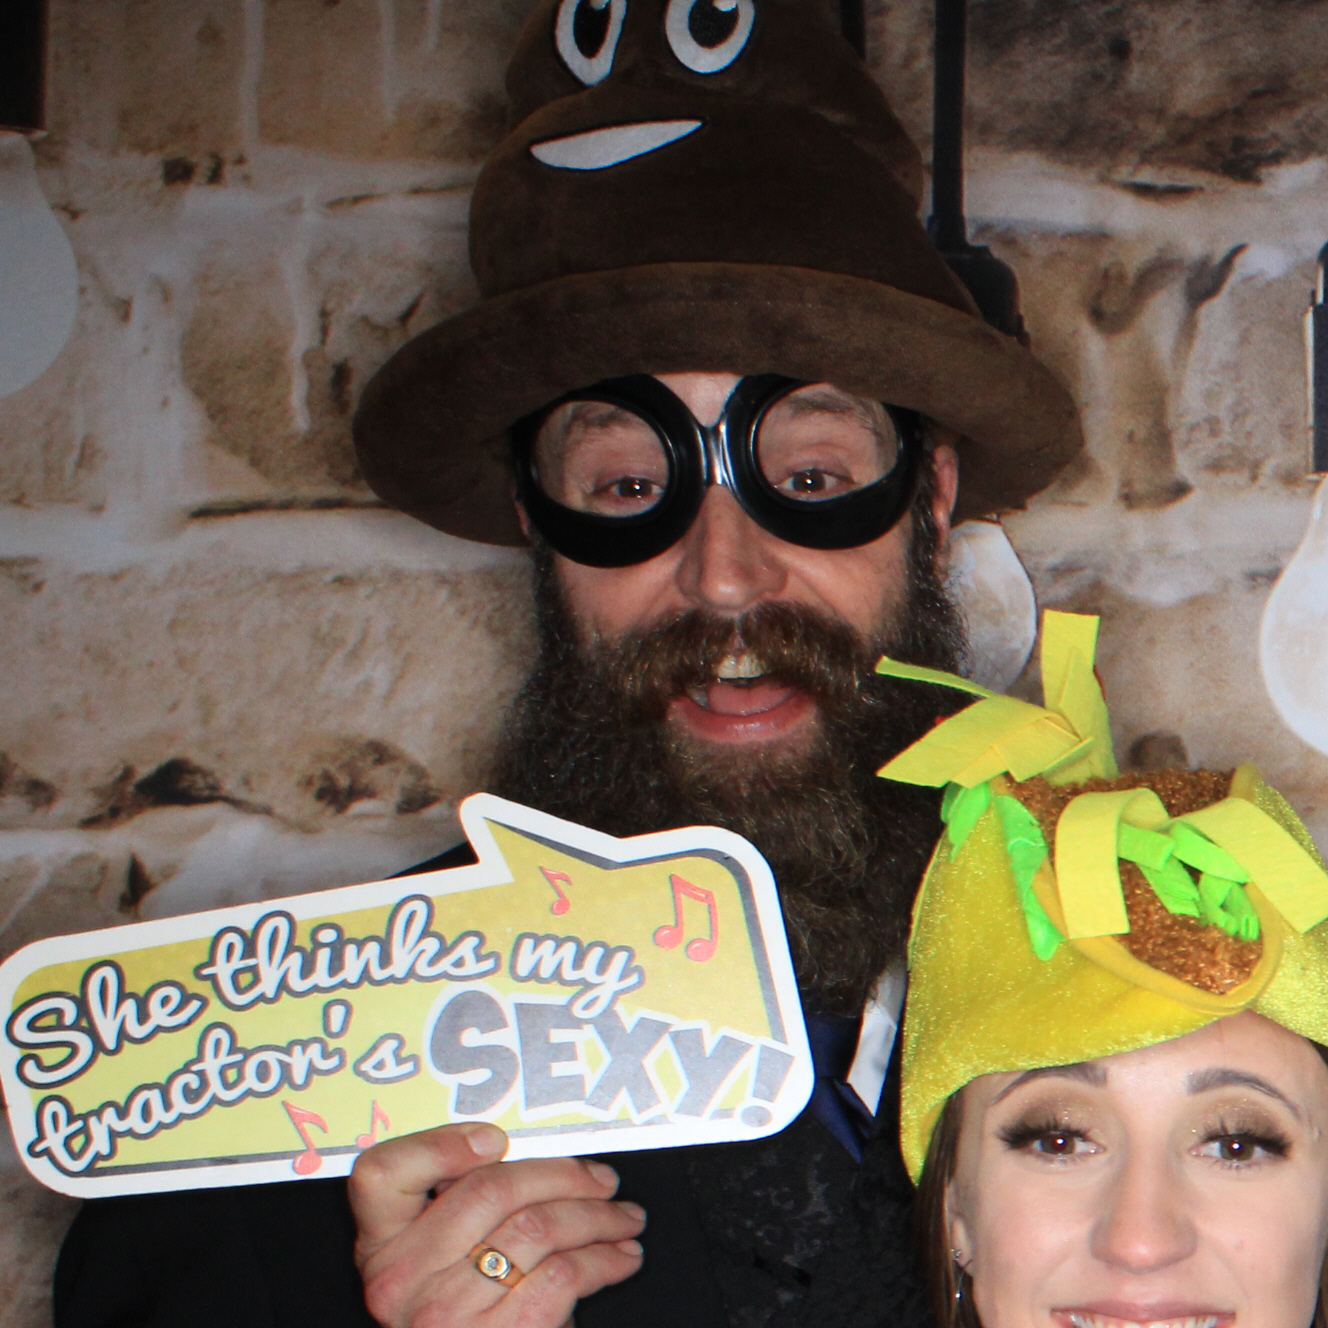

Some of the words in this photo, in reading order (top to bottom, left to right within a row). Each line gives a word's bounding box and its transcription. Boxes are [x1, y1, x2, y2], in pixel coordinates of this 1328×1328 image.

[9, 963, 200, 1086] She
[204, 897, 497, 1005] thinks
[516, 931, 643, 1018] my
[33, 1001, 420, 1173] tractor's
[429, 990, 796, 1127] SEXY!
